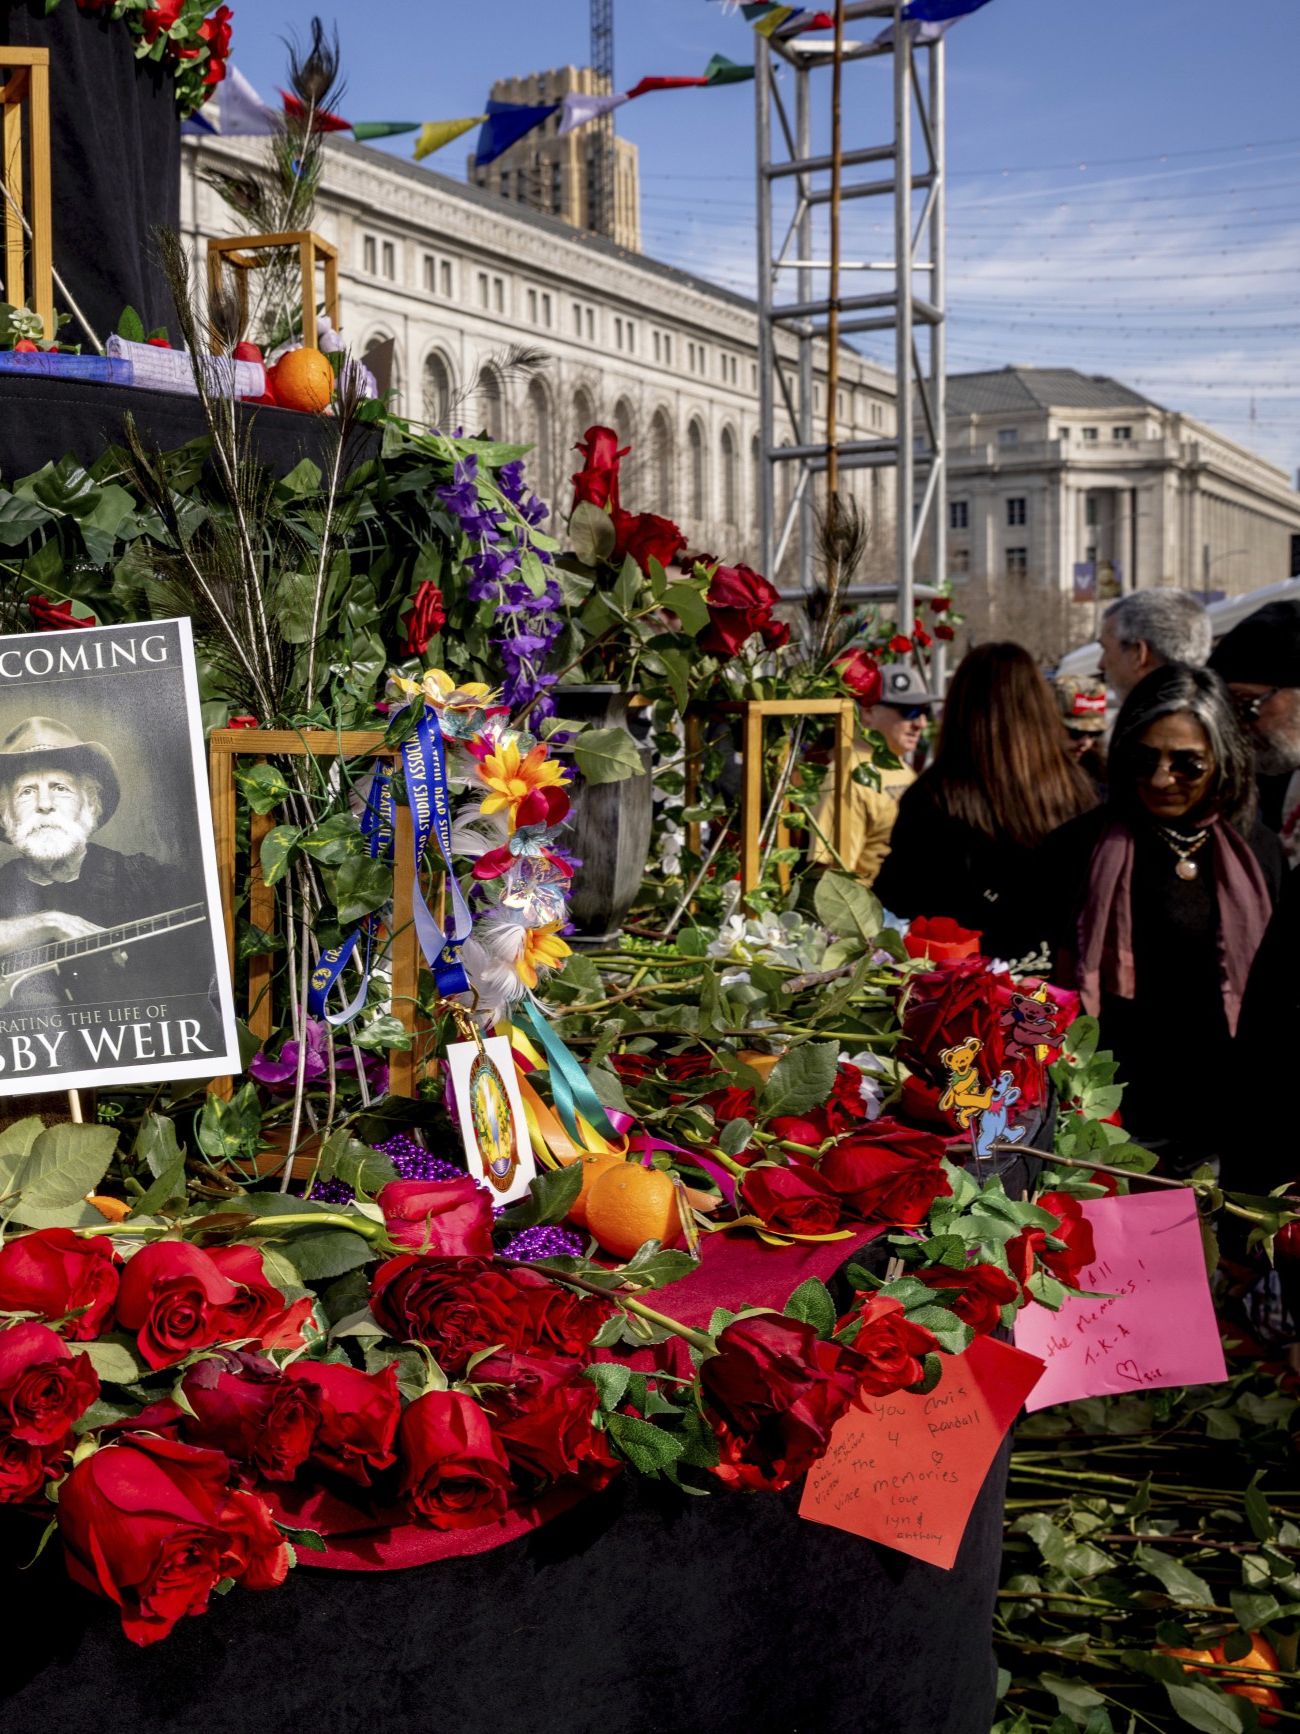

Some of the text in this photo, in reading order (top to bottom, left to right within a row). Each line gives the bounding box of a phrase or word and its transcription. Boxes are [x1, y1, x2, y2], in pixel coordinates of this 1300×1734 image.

[405, 727, 428, 780] ASSOCIA
[378, 783, 393, 838] GRATEUL
[413, 784, 431, 831] STUDIES
[67, 1011, 102, 1026] THE
[108, 1006, 142, 1022] LIFE
[146, 1004, 169, 1018] OF
[77, 1018, 215, 1064] WEIR
[873, 1401, 907, 1422] you
[887, 1430, 900, 1448] 4
